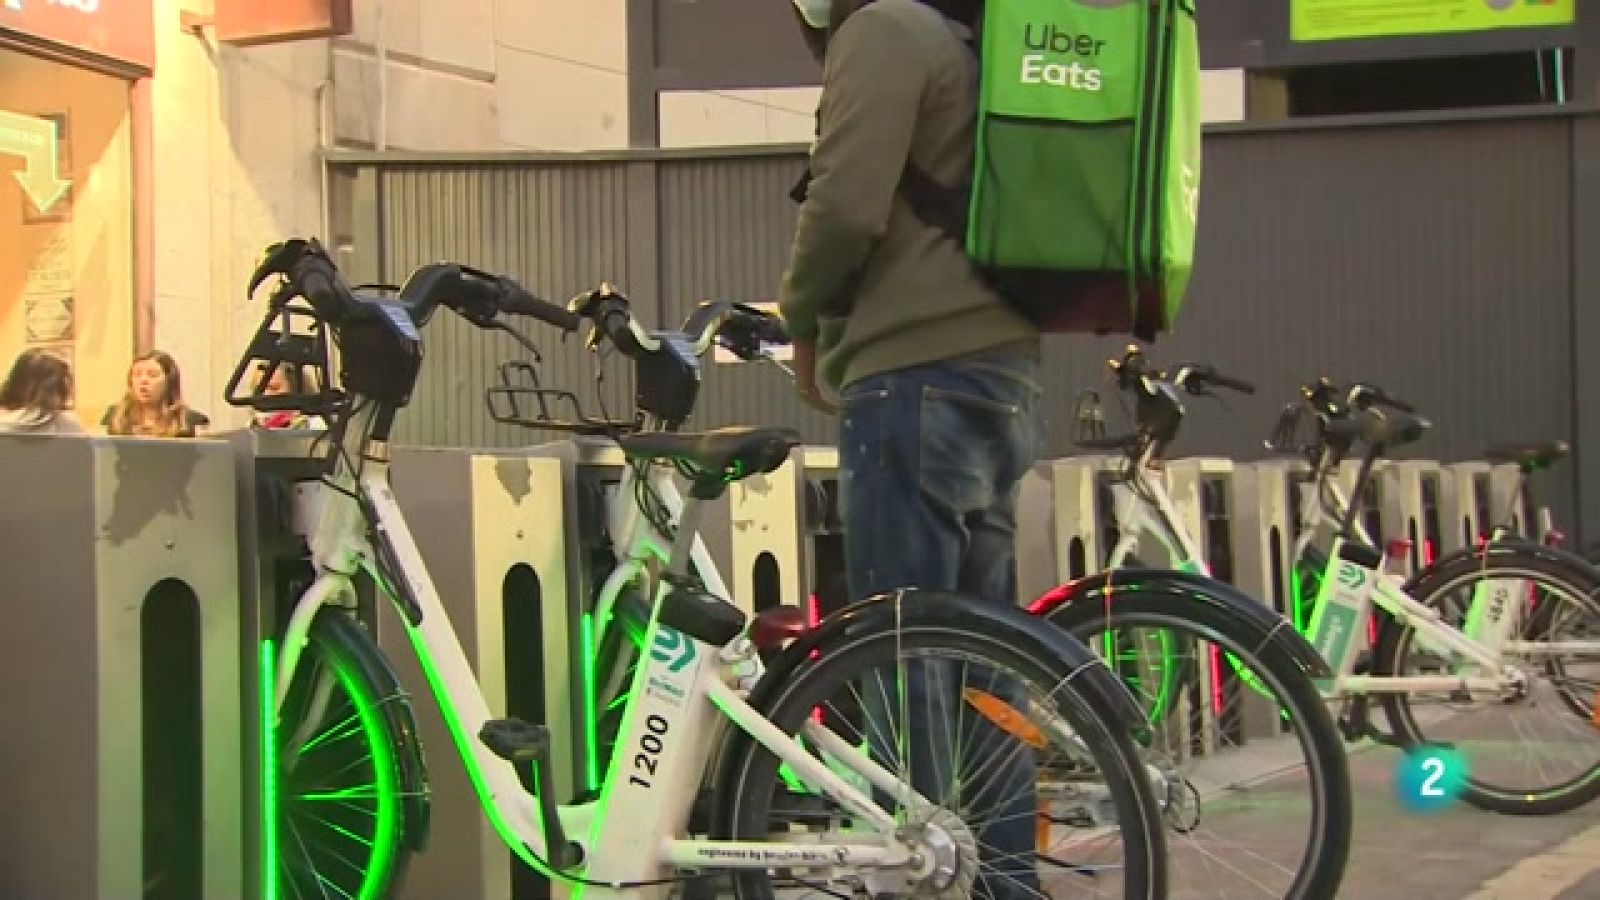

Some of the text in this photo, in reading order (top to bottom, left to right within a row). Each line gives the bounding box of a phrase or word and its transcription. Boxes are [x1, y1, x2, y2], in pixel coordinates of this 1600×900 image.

[1025, 22, 1107, 56] Uber
[1020, 55, 1101, 91] Eats
[630, 714, 669, 788] 1200
